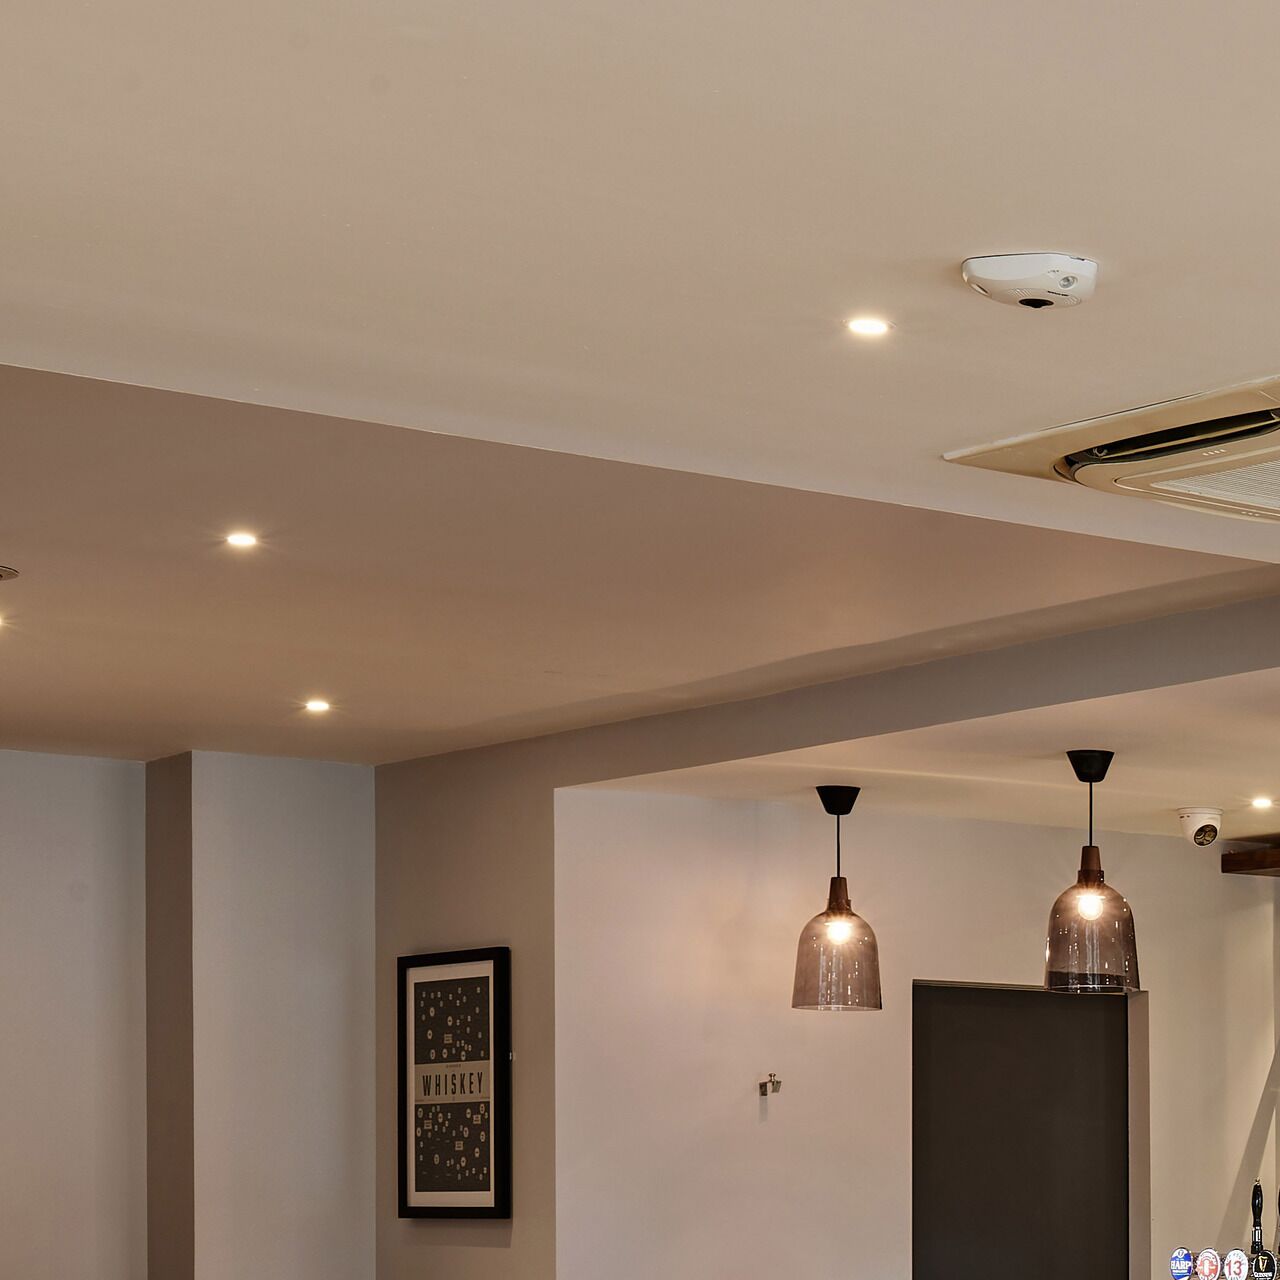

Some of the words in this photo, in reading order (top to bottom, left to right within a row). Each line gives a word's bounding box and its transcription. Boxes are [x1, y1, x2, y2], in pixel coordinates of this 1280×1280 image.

[422, 1071, 484, 1097] WHISKEY
[1171, 1260, 1192, 1270] HARP
[1226, 1260, 1242, 1277] 13
